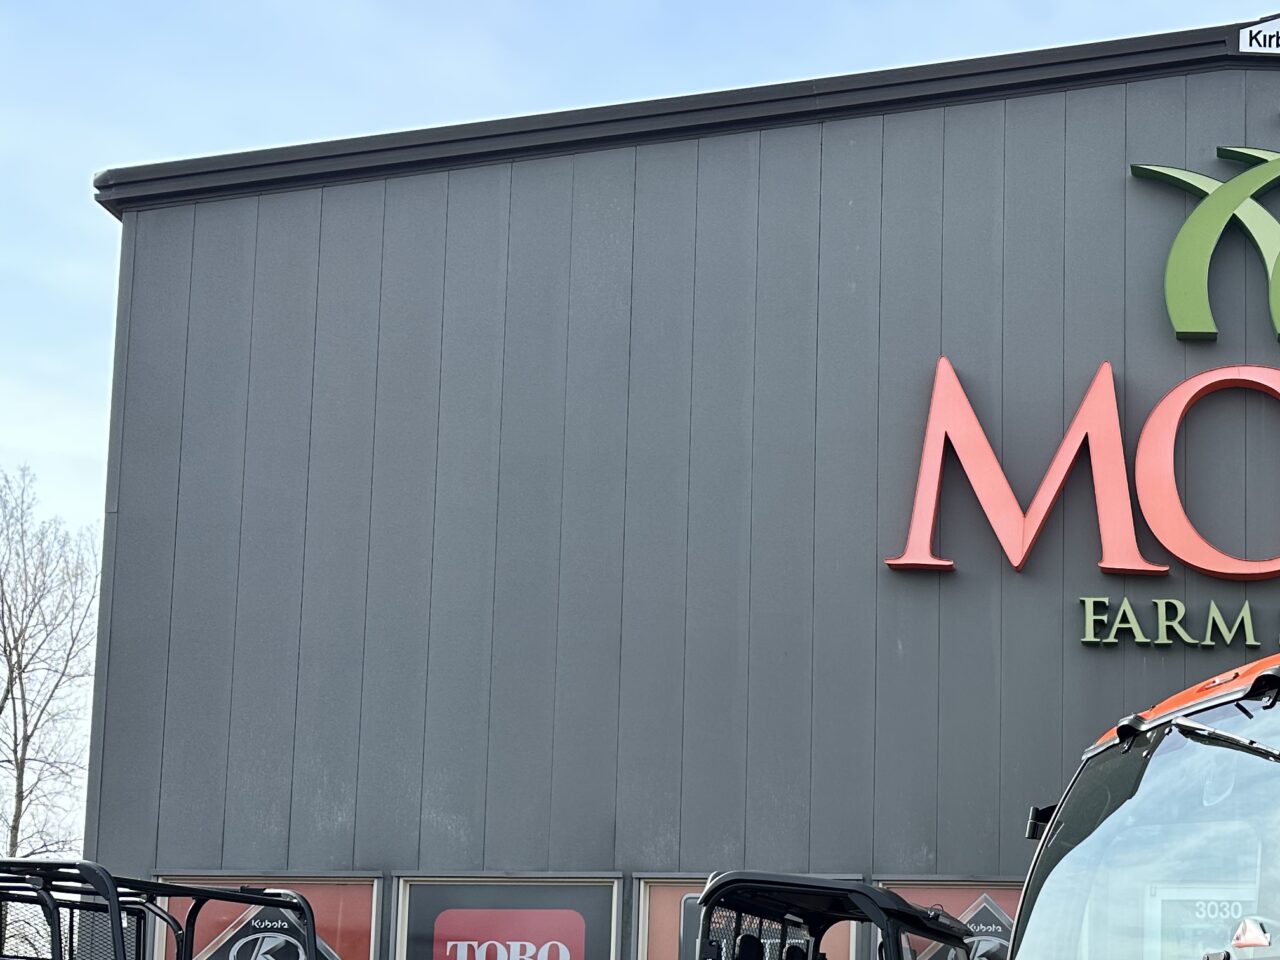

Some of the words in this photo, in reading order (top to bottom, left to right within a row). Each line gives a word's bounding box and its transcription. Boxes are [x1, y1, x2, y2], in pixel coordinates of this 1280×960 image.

[1080, 596, 1261, 647] FARM
[1195, 901, 1243, 920] 3030
[251, 919, 289, 929] Kubota
[967, 923, 1002, 933] Kubota
